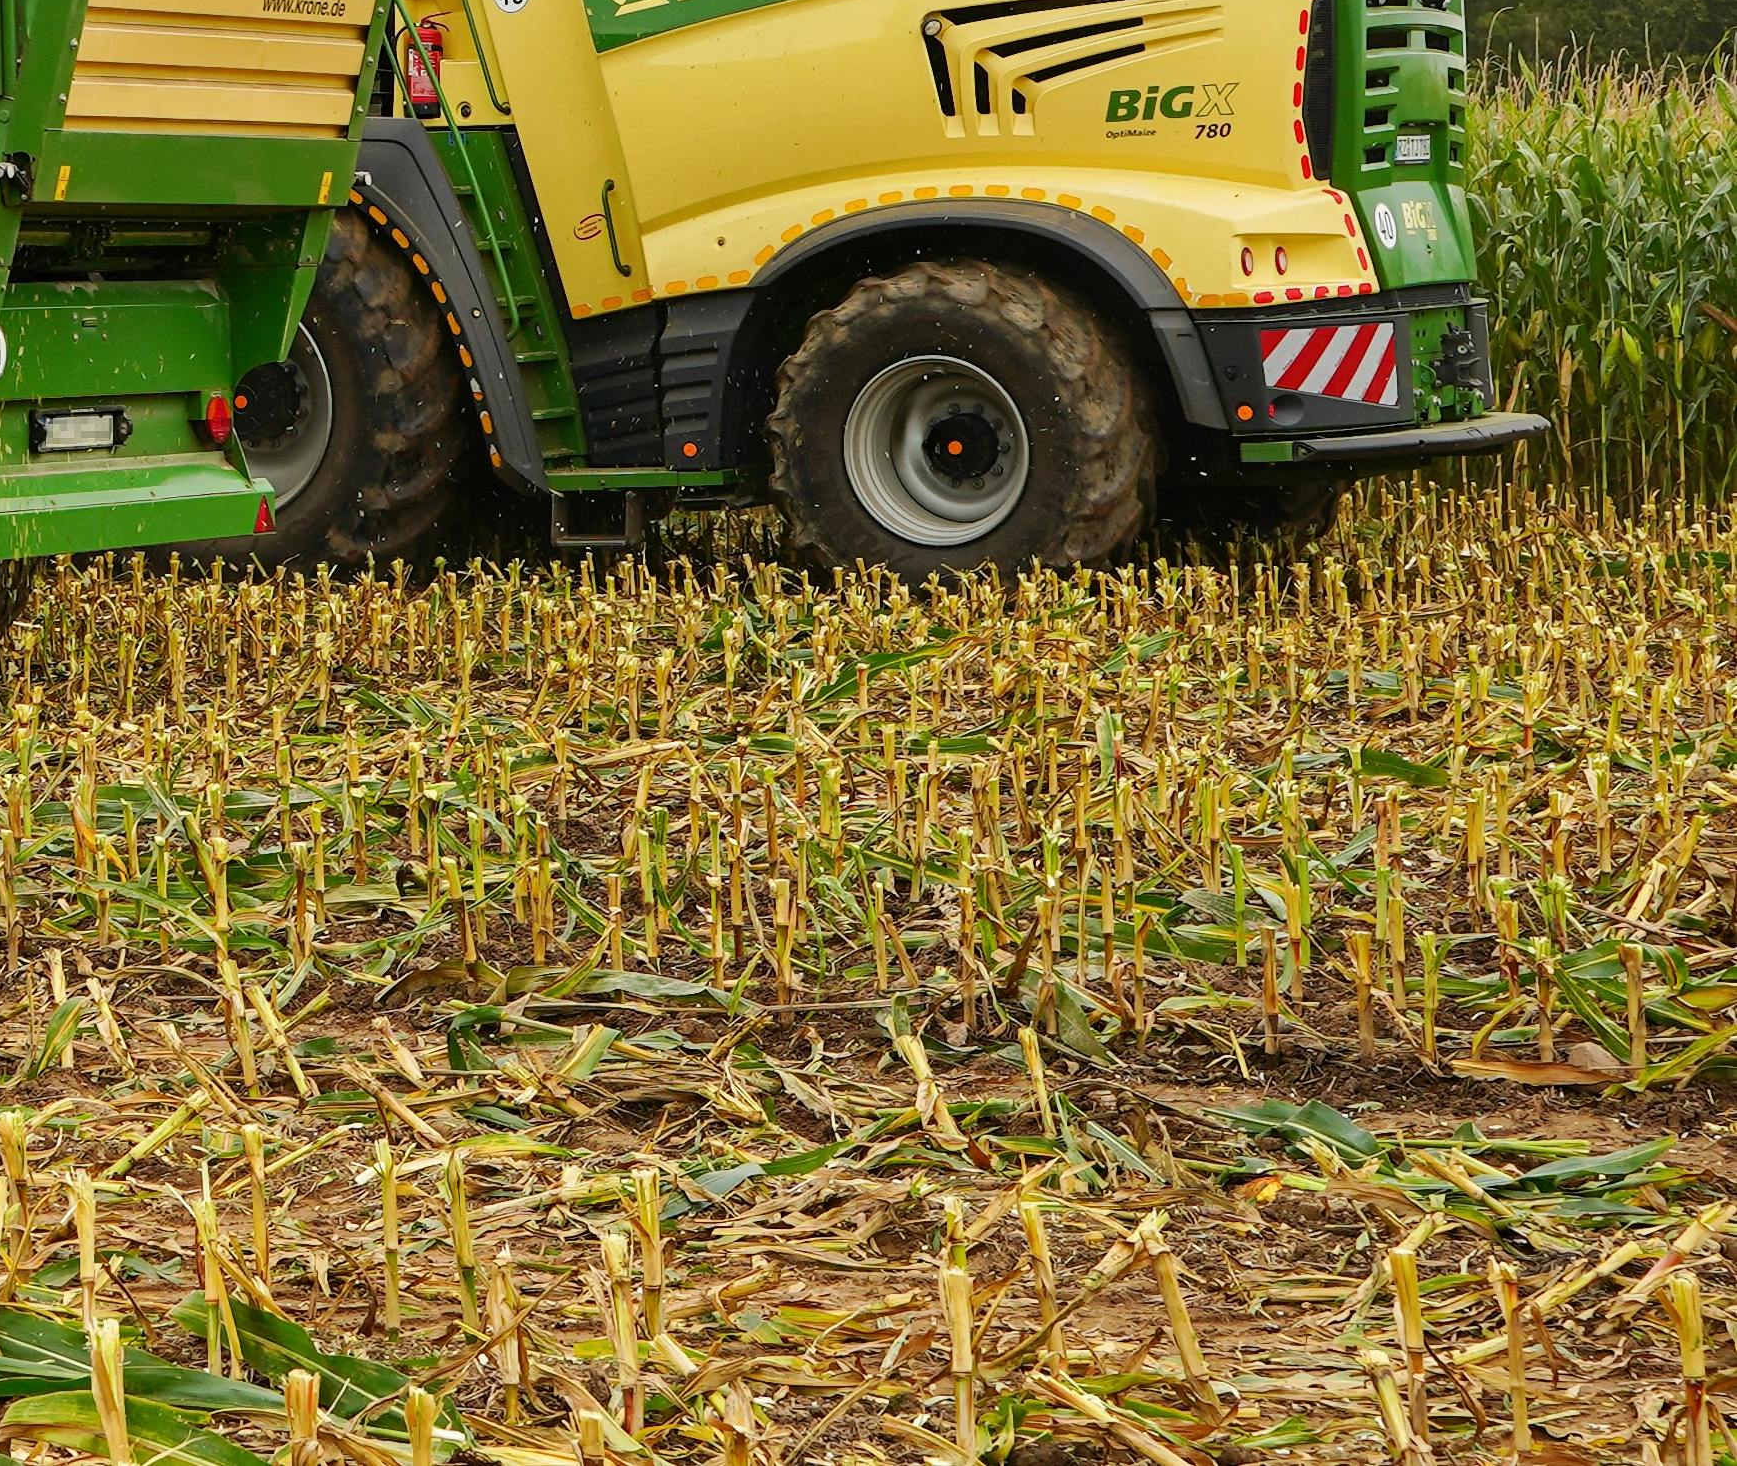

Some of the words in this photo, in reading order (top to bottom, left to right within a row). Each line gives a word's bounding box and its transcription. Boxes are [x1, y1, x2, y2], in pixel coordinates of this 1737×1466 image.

[1105, 128, 1157, 140] OptiMaize
[1194, 122, 1232, 140] 780
[1377, 210, 1395, 240] 40
